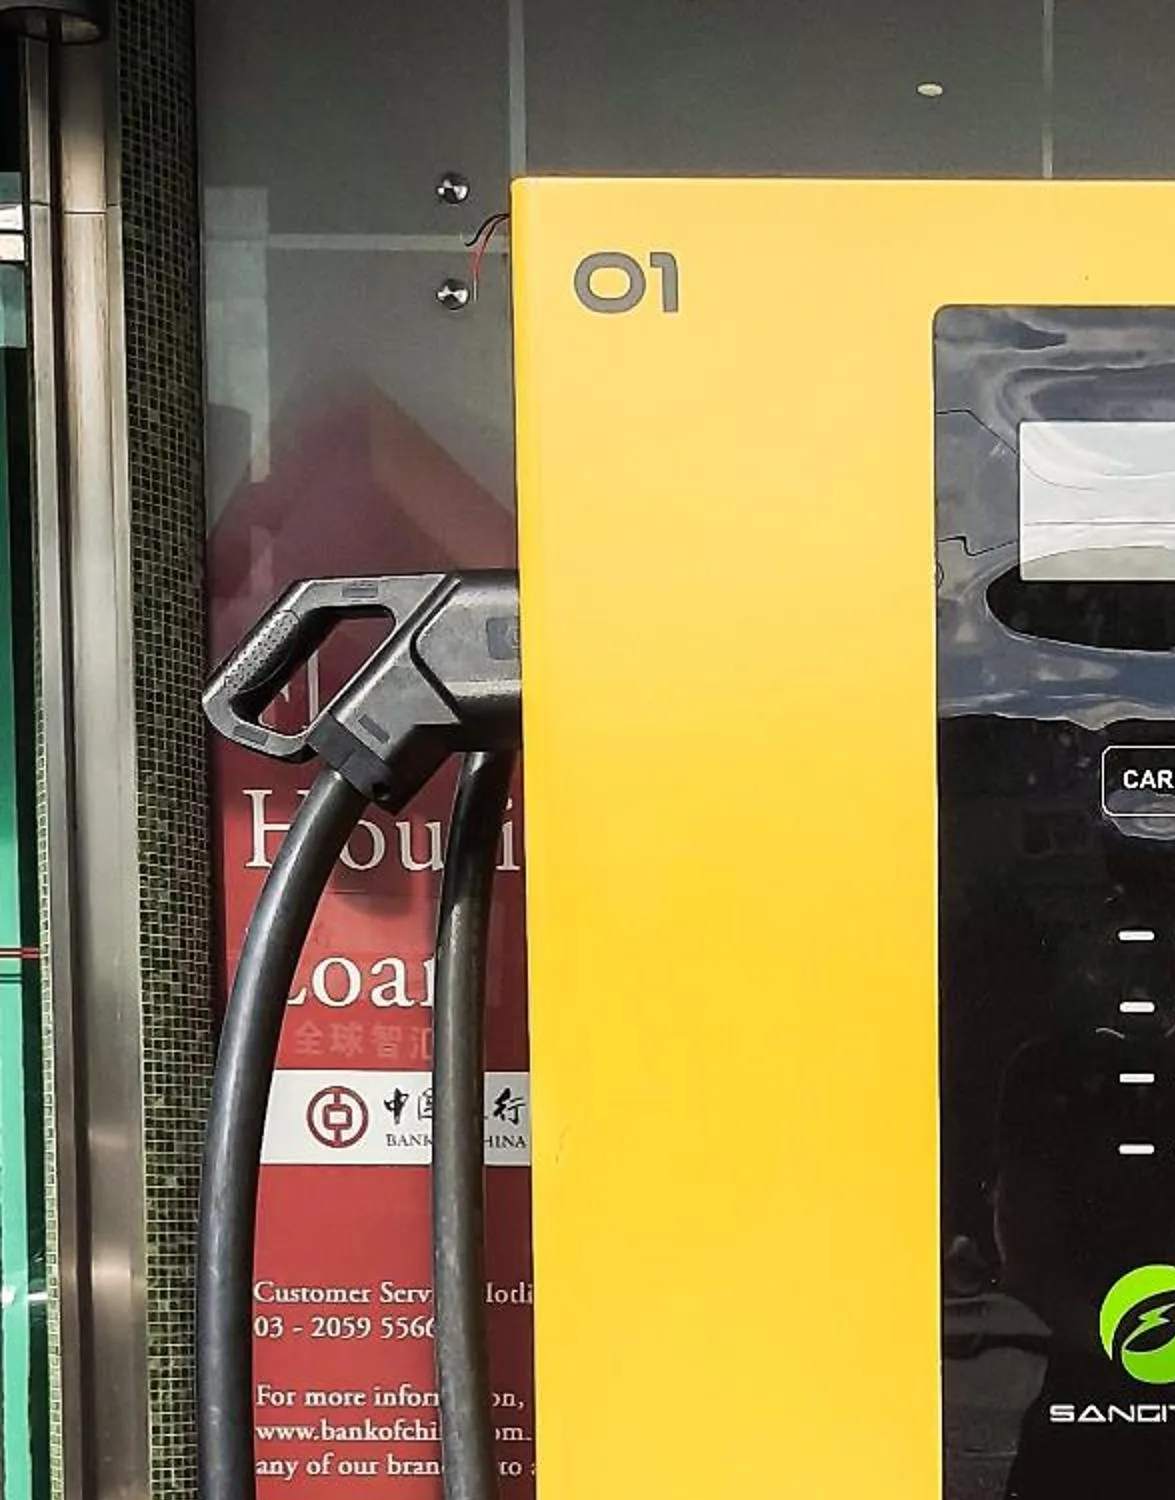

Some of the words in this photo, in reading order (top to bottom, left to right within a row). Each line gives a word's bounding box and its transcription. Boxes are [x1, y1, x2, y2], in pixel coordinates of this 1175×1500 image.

[574, 252, 679, 313] 01
[254, 1281, 371, 1303] Customer
[254, 1316, 284, 1338] 03
[311, 1316, 371, 1339] 2059
[256, 1384, 297, 1407] For
[304, 1390, 366, 1407] more
[255, 1460, 298, 1481] any
[306, 1452, 335, 1475] of
[338, 1460, 379, 1475] our
